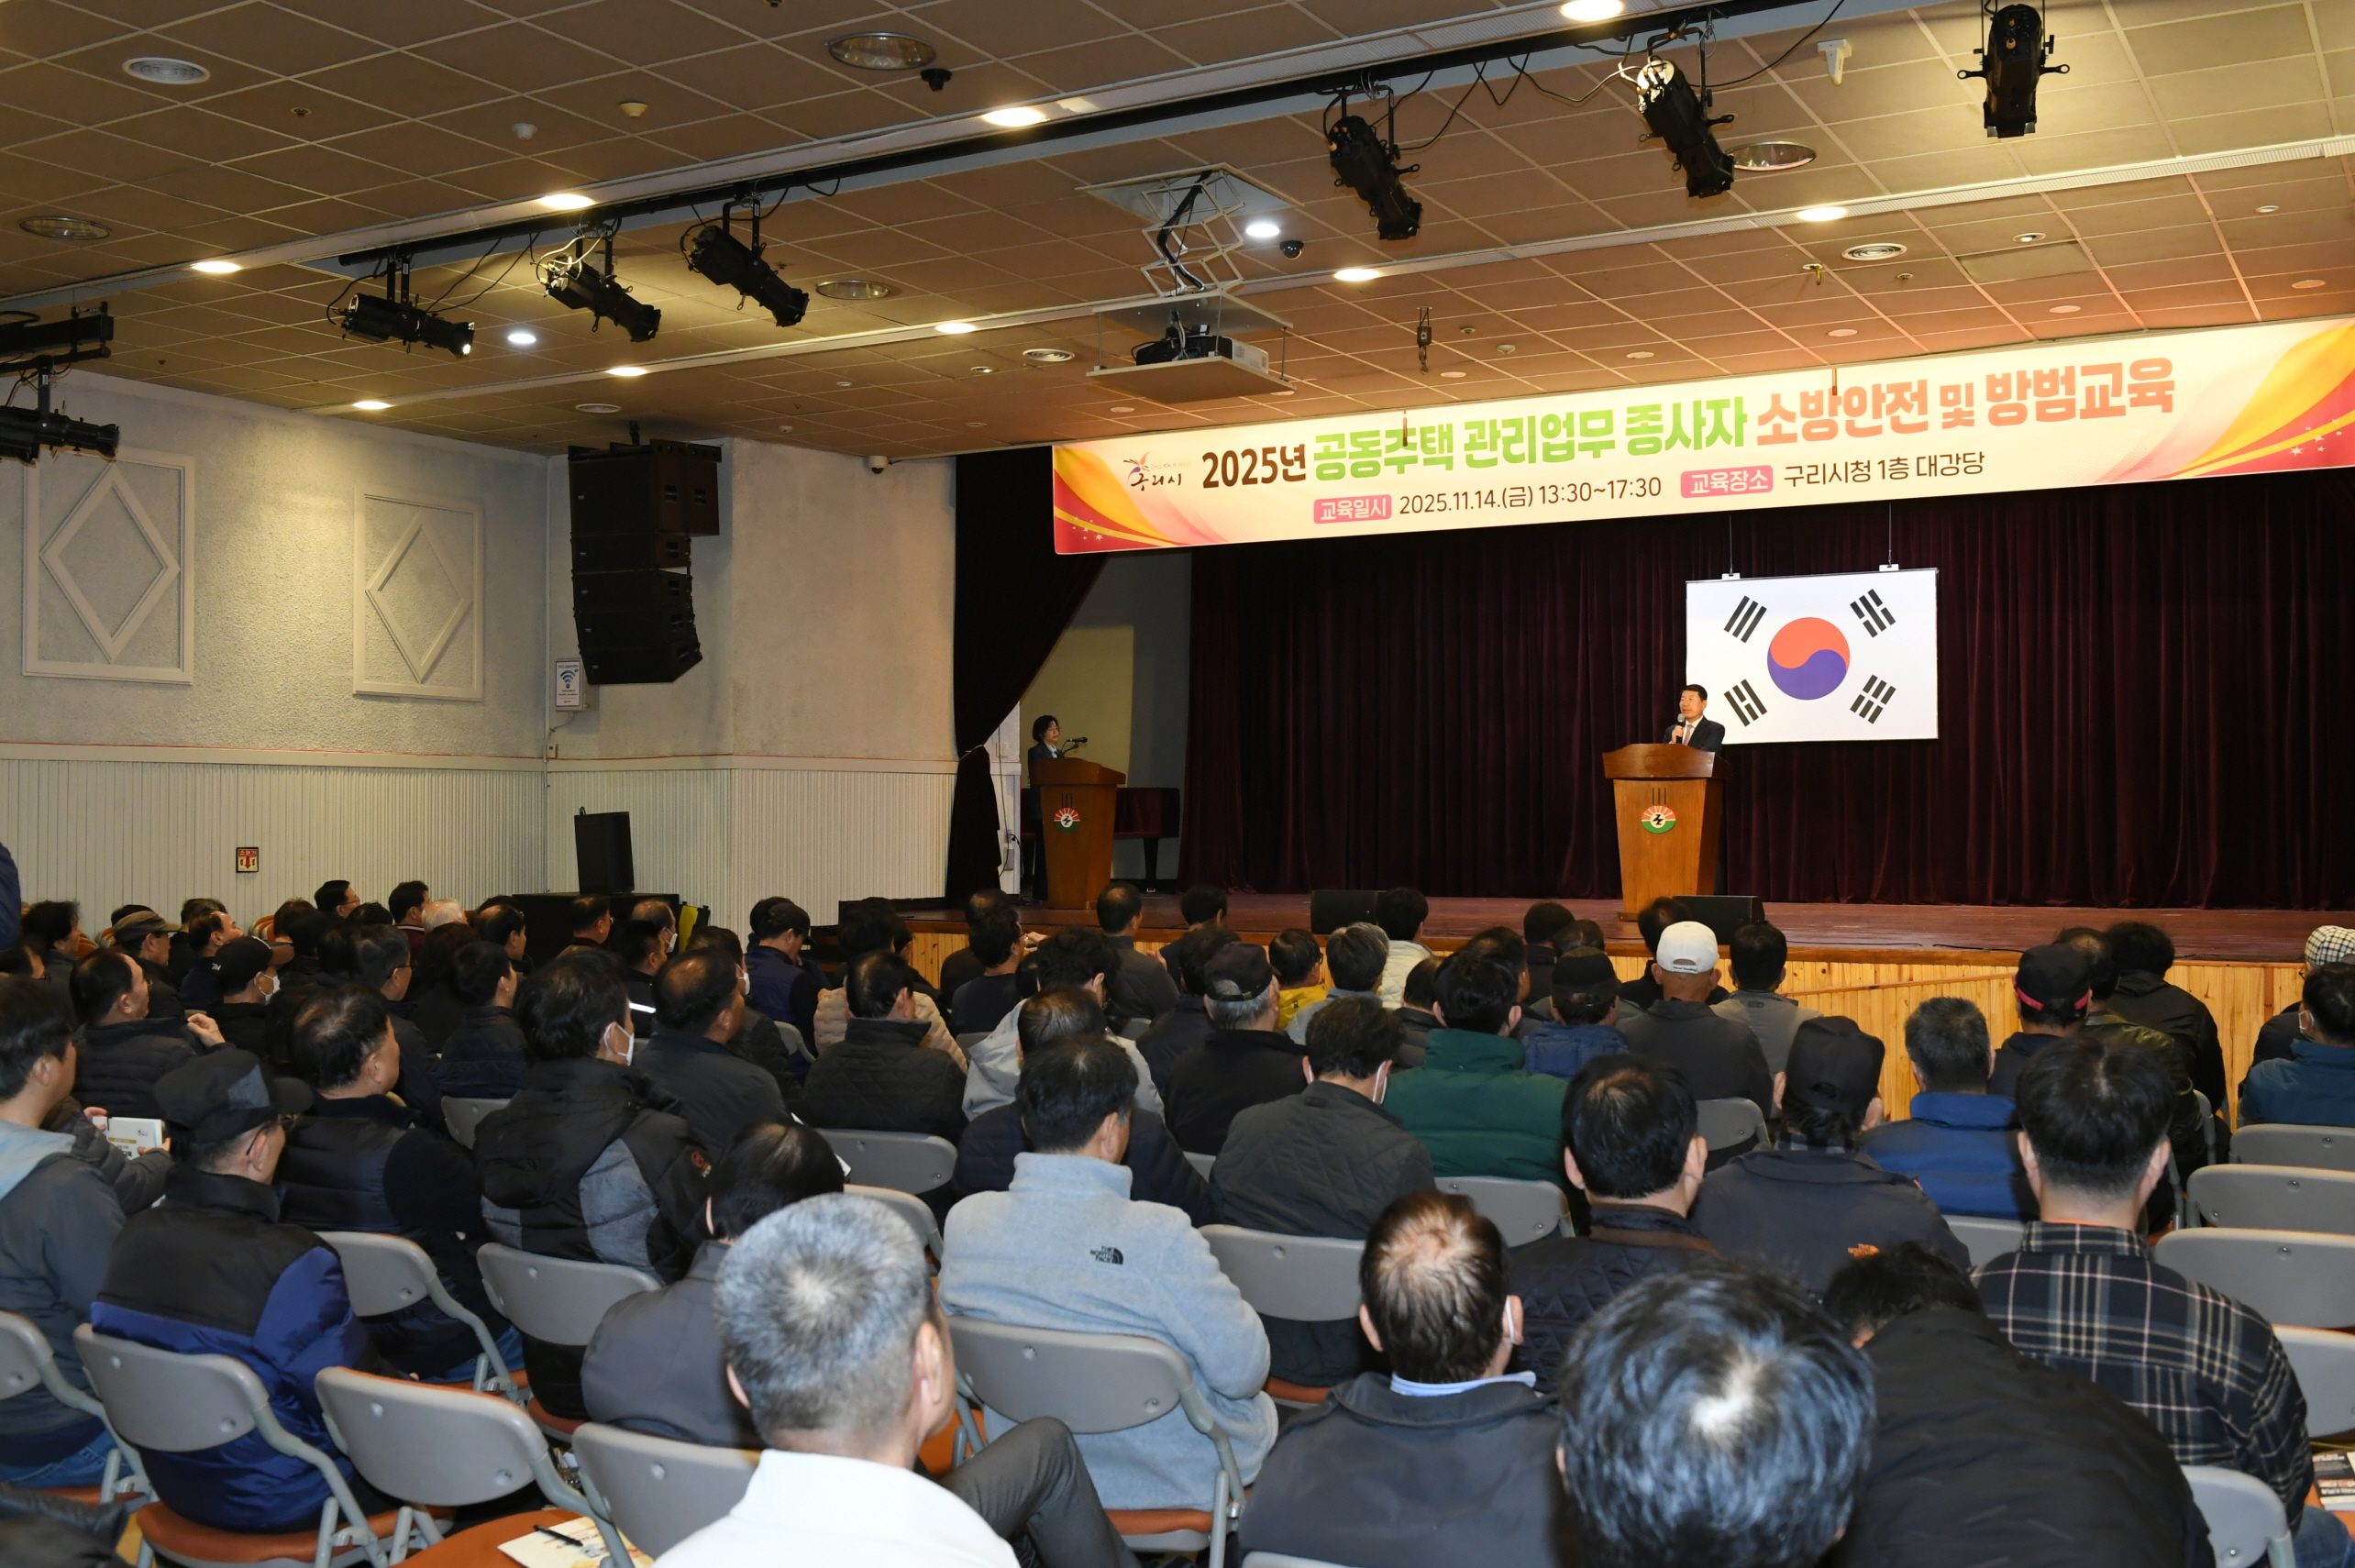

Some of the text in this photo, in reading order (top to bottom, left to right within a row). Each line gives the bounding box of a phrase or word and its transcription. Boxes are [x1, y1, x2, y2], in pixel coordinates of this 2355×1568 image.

[1201, 358, 2175, 489] 2025년 공동주택 관리업무 종사자 소방안전 및 방범교육
[1131, 472, 1182, 491] 구리시
[1320, 451, 1985, 521] 교육일시 2025.11.14.(금) 13:30~17:30 교육장소 구리시청 1층 대강당
